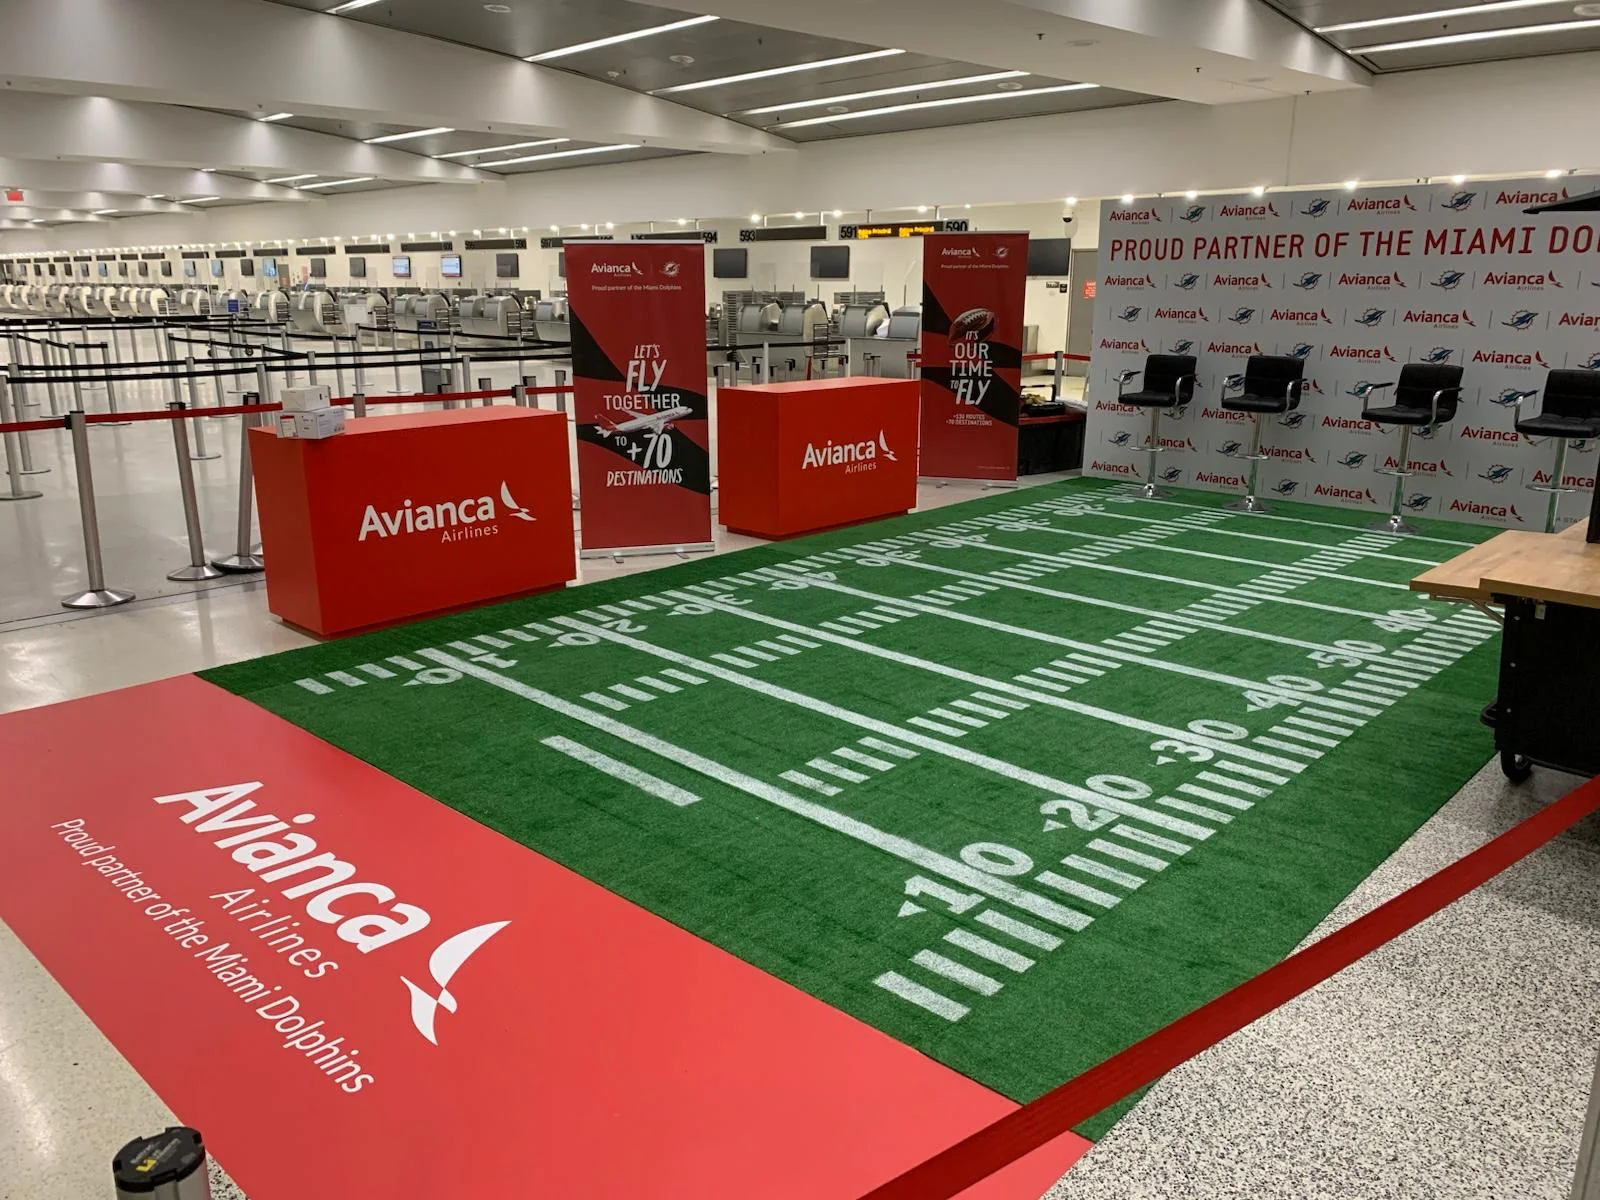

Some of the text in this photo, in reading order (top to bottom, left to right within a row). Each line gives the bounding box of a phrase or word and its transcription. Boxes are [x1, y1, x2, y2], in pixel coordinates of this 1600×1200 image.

[1496, 190, 1558, 204] Avianca
[1220, 205, 1266, 217] Avianca
[1347, 198, 1401, 211] Avianca
[1109, 210, 1150, 221] Avianca
[702, 232, 717, 243] 594
[740, 230, 755, 241] 593
[841, 225, 857, 239] 591
[1110, 238, 1184, 261] PROUD
[1193, 234, 1305, 260] PARTNER
[1315, 232, 1349, 258] OF
[1359, 230, 1414, 257] THE
[1423, 227, 1537, 255] MIAMI
[941, 248, 972, 256] Avianca
[591, 262, 631, 274] Avianca
[1105, 275, 1144, 286] Avianca
[1213, 274, 1258, 286] Avianca
[1338, 273, 1391, 285] Avianca
[1483, 272, 1544, 285] Avianca
[1155, 307, 1197, 319] Avianca
[1270, 309, 1318, 321] Avianca
[1403, 310, 1459, 323] Avianca
[966, 331, 979, 340] IT'S
[634, 344, 660, 359] LET'S
[955, 343, 989, 359] OUR
[1100, 339, 1139, 350] Avianca
[1207, 342, 1252, 354] Avianca
[1330, 346, 1381, 359] Avianca
[1472, 350, 1532, 364] Avianca
[949, 360, 993, 377] TIME
[626, 359, 667, 393] FLY
[956, 379, 991, 405] FLY
[603, 393, 680, 411] TOGETHER
[1096, 400, 1134, 412] Avianca
[1202, 408, 1245, 421] Avianca
[1322, 416, 1372, 430] Avianca
[1461, 425, 1519, 442] Avianca
[1145, 435, 1185, 448] Aianca
[615, 433, 672, 469] TO +70
[802, 440, 876, 470] Avianca
[1259, 446, 1302, 459] Avianca
[845, 462, 877, 475] Airlines
[1092, 461, 1129, 473] Avianca
[1384, 456, 1437, 472] Avanca
[606, 468, 683, 488] DESTINATIONS
[1196, 472, 1239, 485] Avianca
[1314, 484, 1363, 499] Avianca
[1449, 499, 1507, 517] Avianca
[358, 499, 496, 541] Avianca
[441, 524, 499, 543] Airlines
[557, 619, 648, 646] 20
[1307, 640, 1386, 669] 50
[414, 653, 518, 684] 10
[1242, 675, 1325, 707] 40
[1150, 720, 1249, 763] 30
[1040, 774, 1153, 831] 20
[153, 781, 431, 954] Avianca
[904, 842, 1034, 914] 10
[209, 888, 339, 979] Airlines
[50, 818, 375, 1093] Proud partner of the Miami Dolphins
